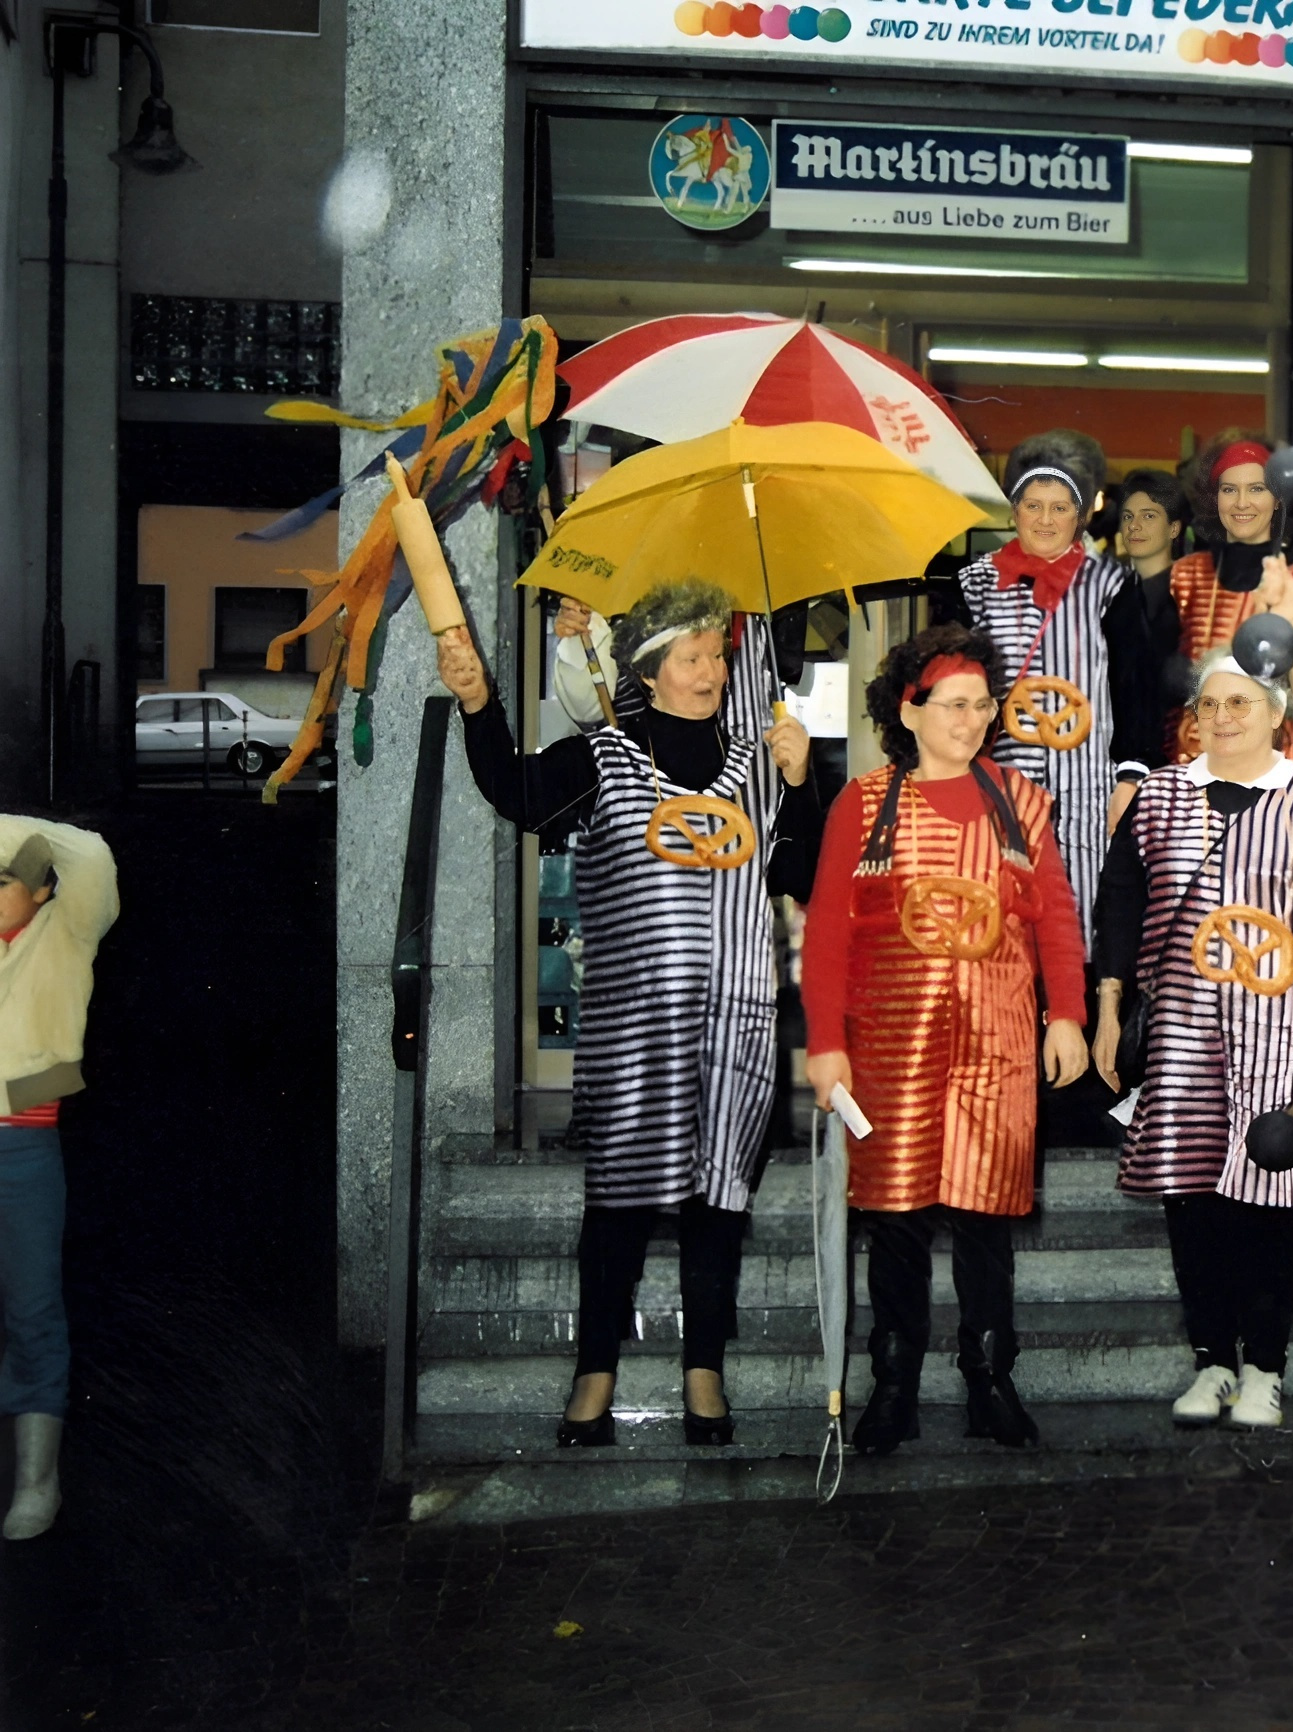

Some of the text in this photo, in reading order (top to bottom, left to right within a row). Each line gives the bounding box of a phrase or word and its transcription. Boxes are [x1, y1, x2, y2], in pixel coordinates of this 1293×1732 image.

[866, 18, 1165, 54] SIND ZU IHREM VORTEIL DA!
[791, 134, 1111, 191] Martinsbräu
[943, 206, 1005, 229] Liebe
[1013, 212, 1060, 231] zum
[1066, 211, 1111, 233] Bier
